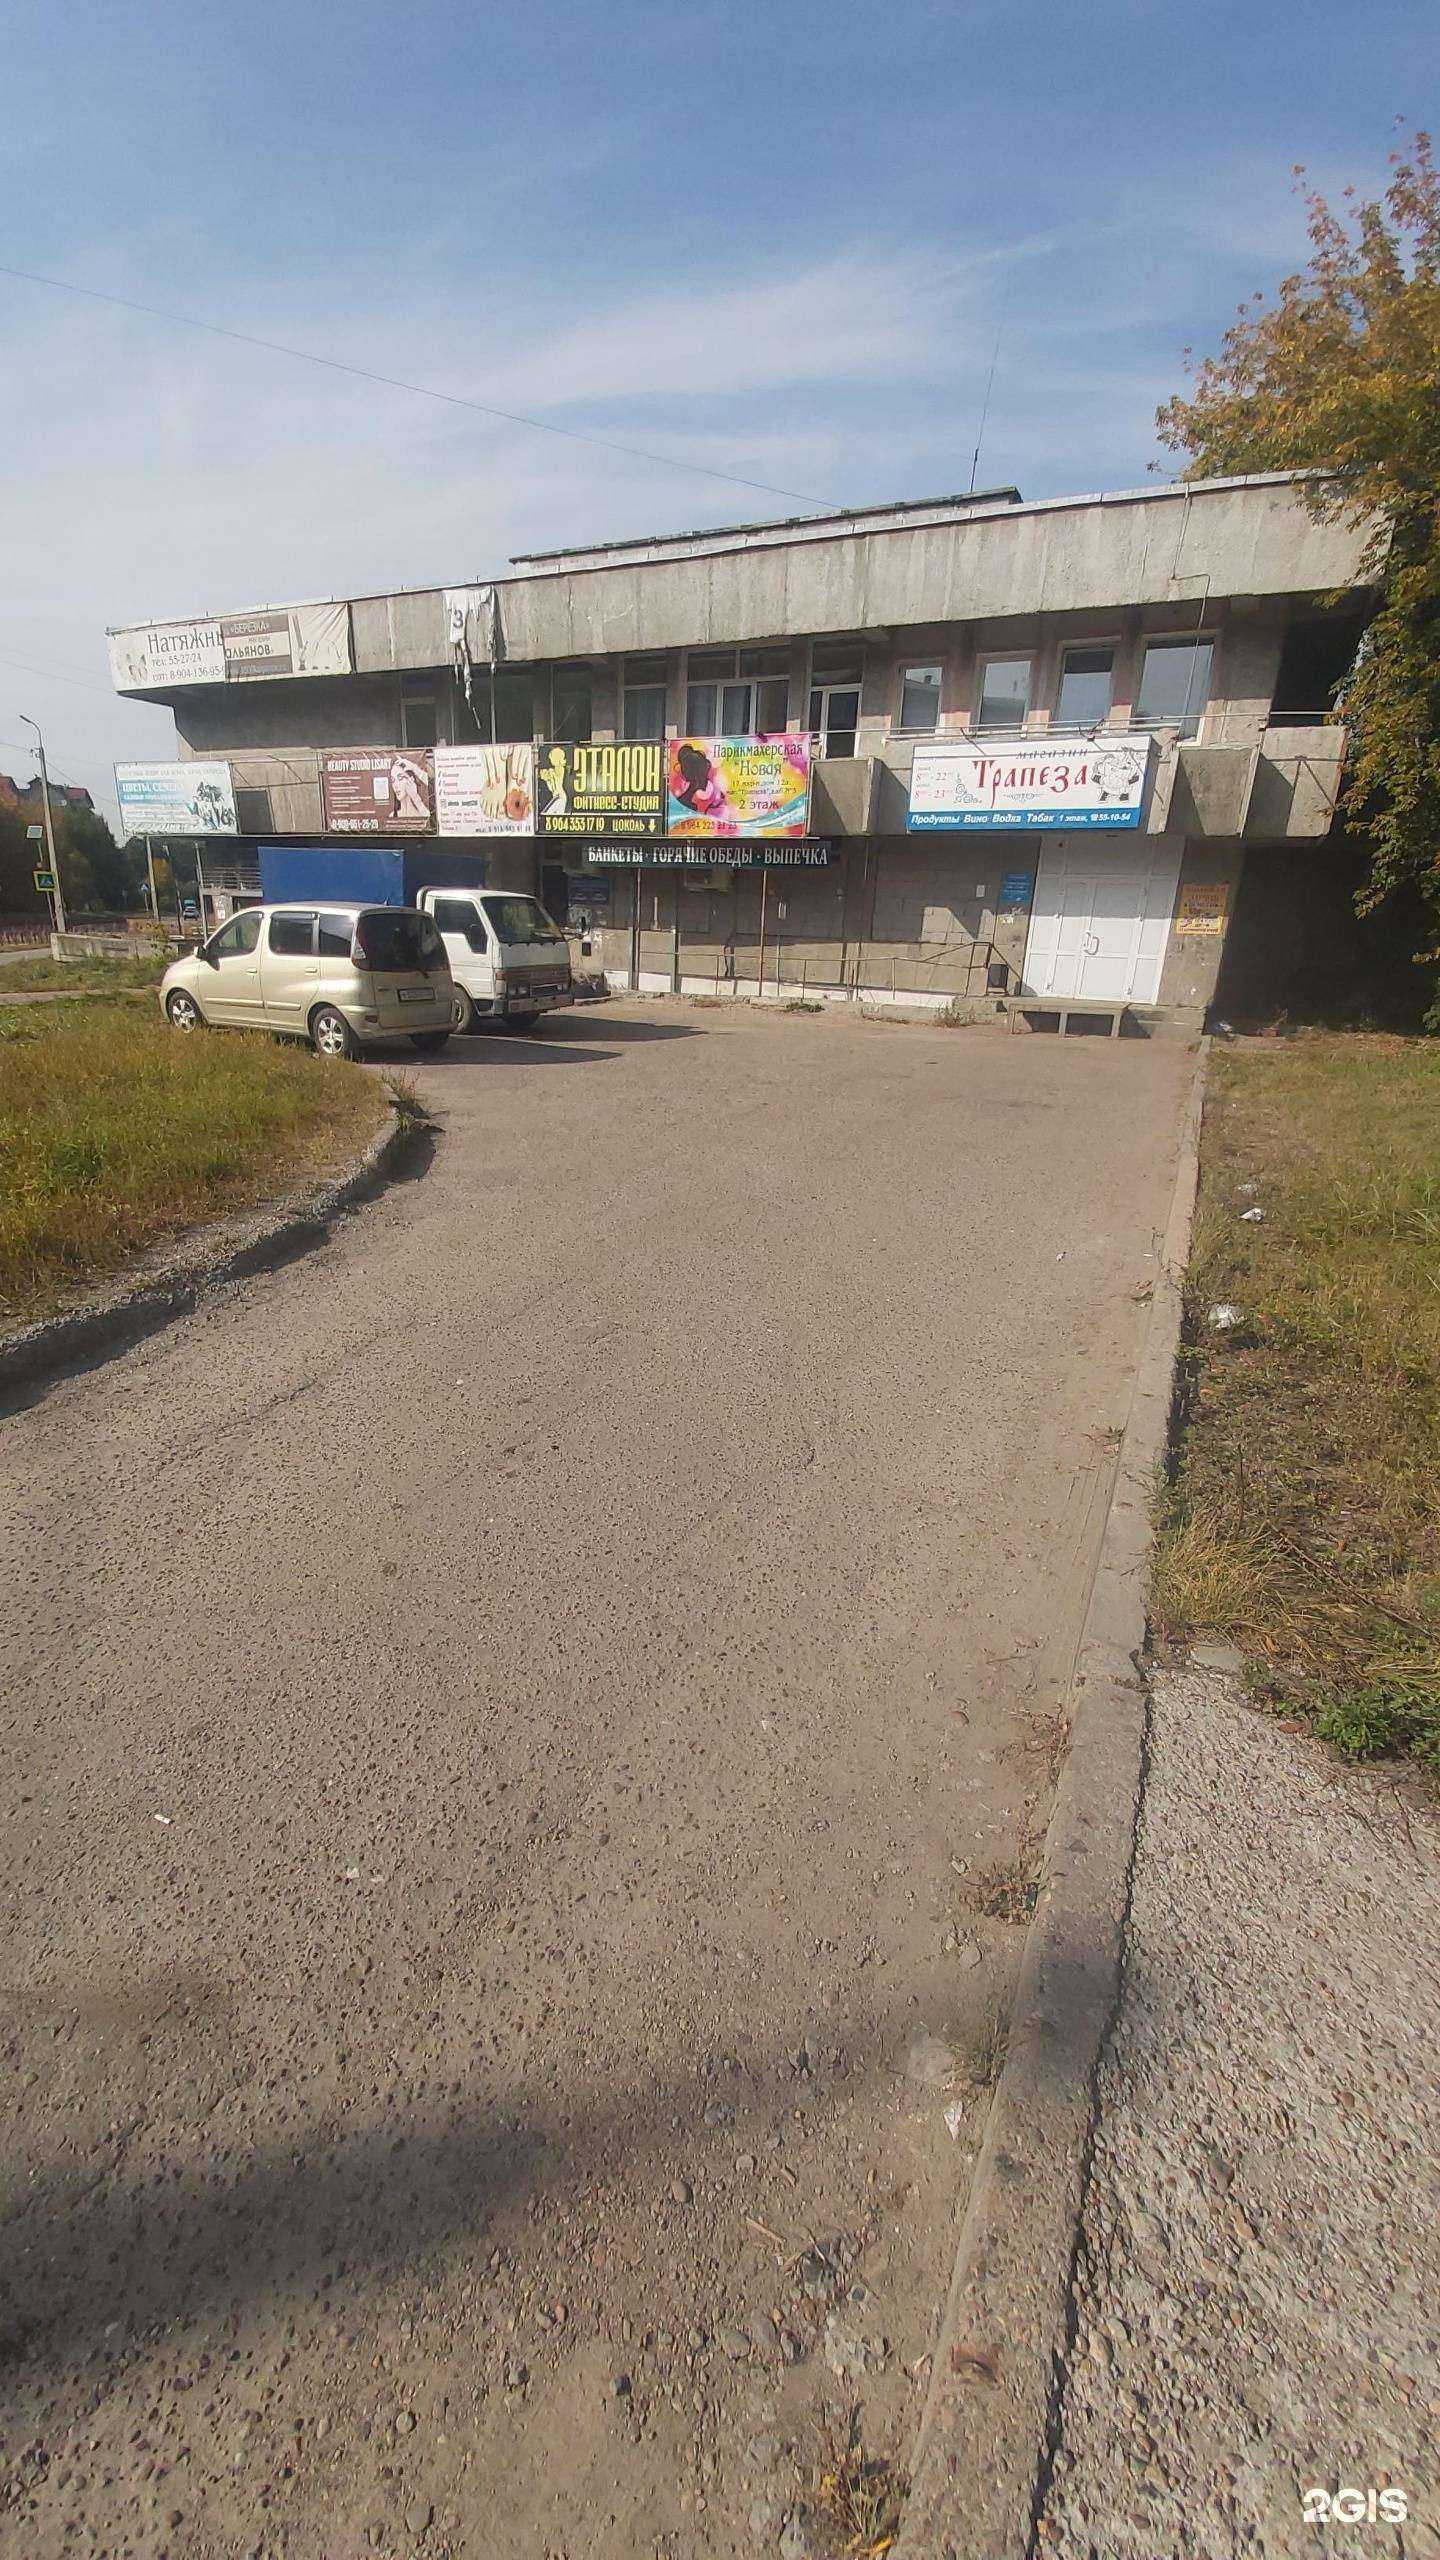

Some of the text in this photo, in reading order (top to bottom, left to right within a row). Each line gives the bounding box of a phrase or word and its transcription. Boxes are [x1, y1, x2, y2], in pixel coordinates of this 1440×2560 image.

[713, 743, 803, 761] Парикмахерская
[327, 760, 349, 771] BEAUTY
[350, 759, 370, 770] STUDIO
[573, 746, 661, 793] ЭТАЛОН
[573, 795, 660, 812] ФИТНЕСС-СТУДИЯ
[739, 799, 780, 810] 2 этаж
[612, 818, 646, 832] ЦОКОЛЬ
[911, 814, 960, 825] Продукты
[963, 814, 989, 823] Вино
[992, 813, 1022, 823] Водка
[1026, 812, 1055, 823] Табак
[588, 846, 828, 867] БАНКЕТЫ ГОРЯЧИЕ ОБЕДЫ ВЫПЕЧКА
